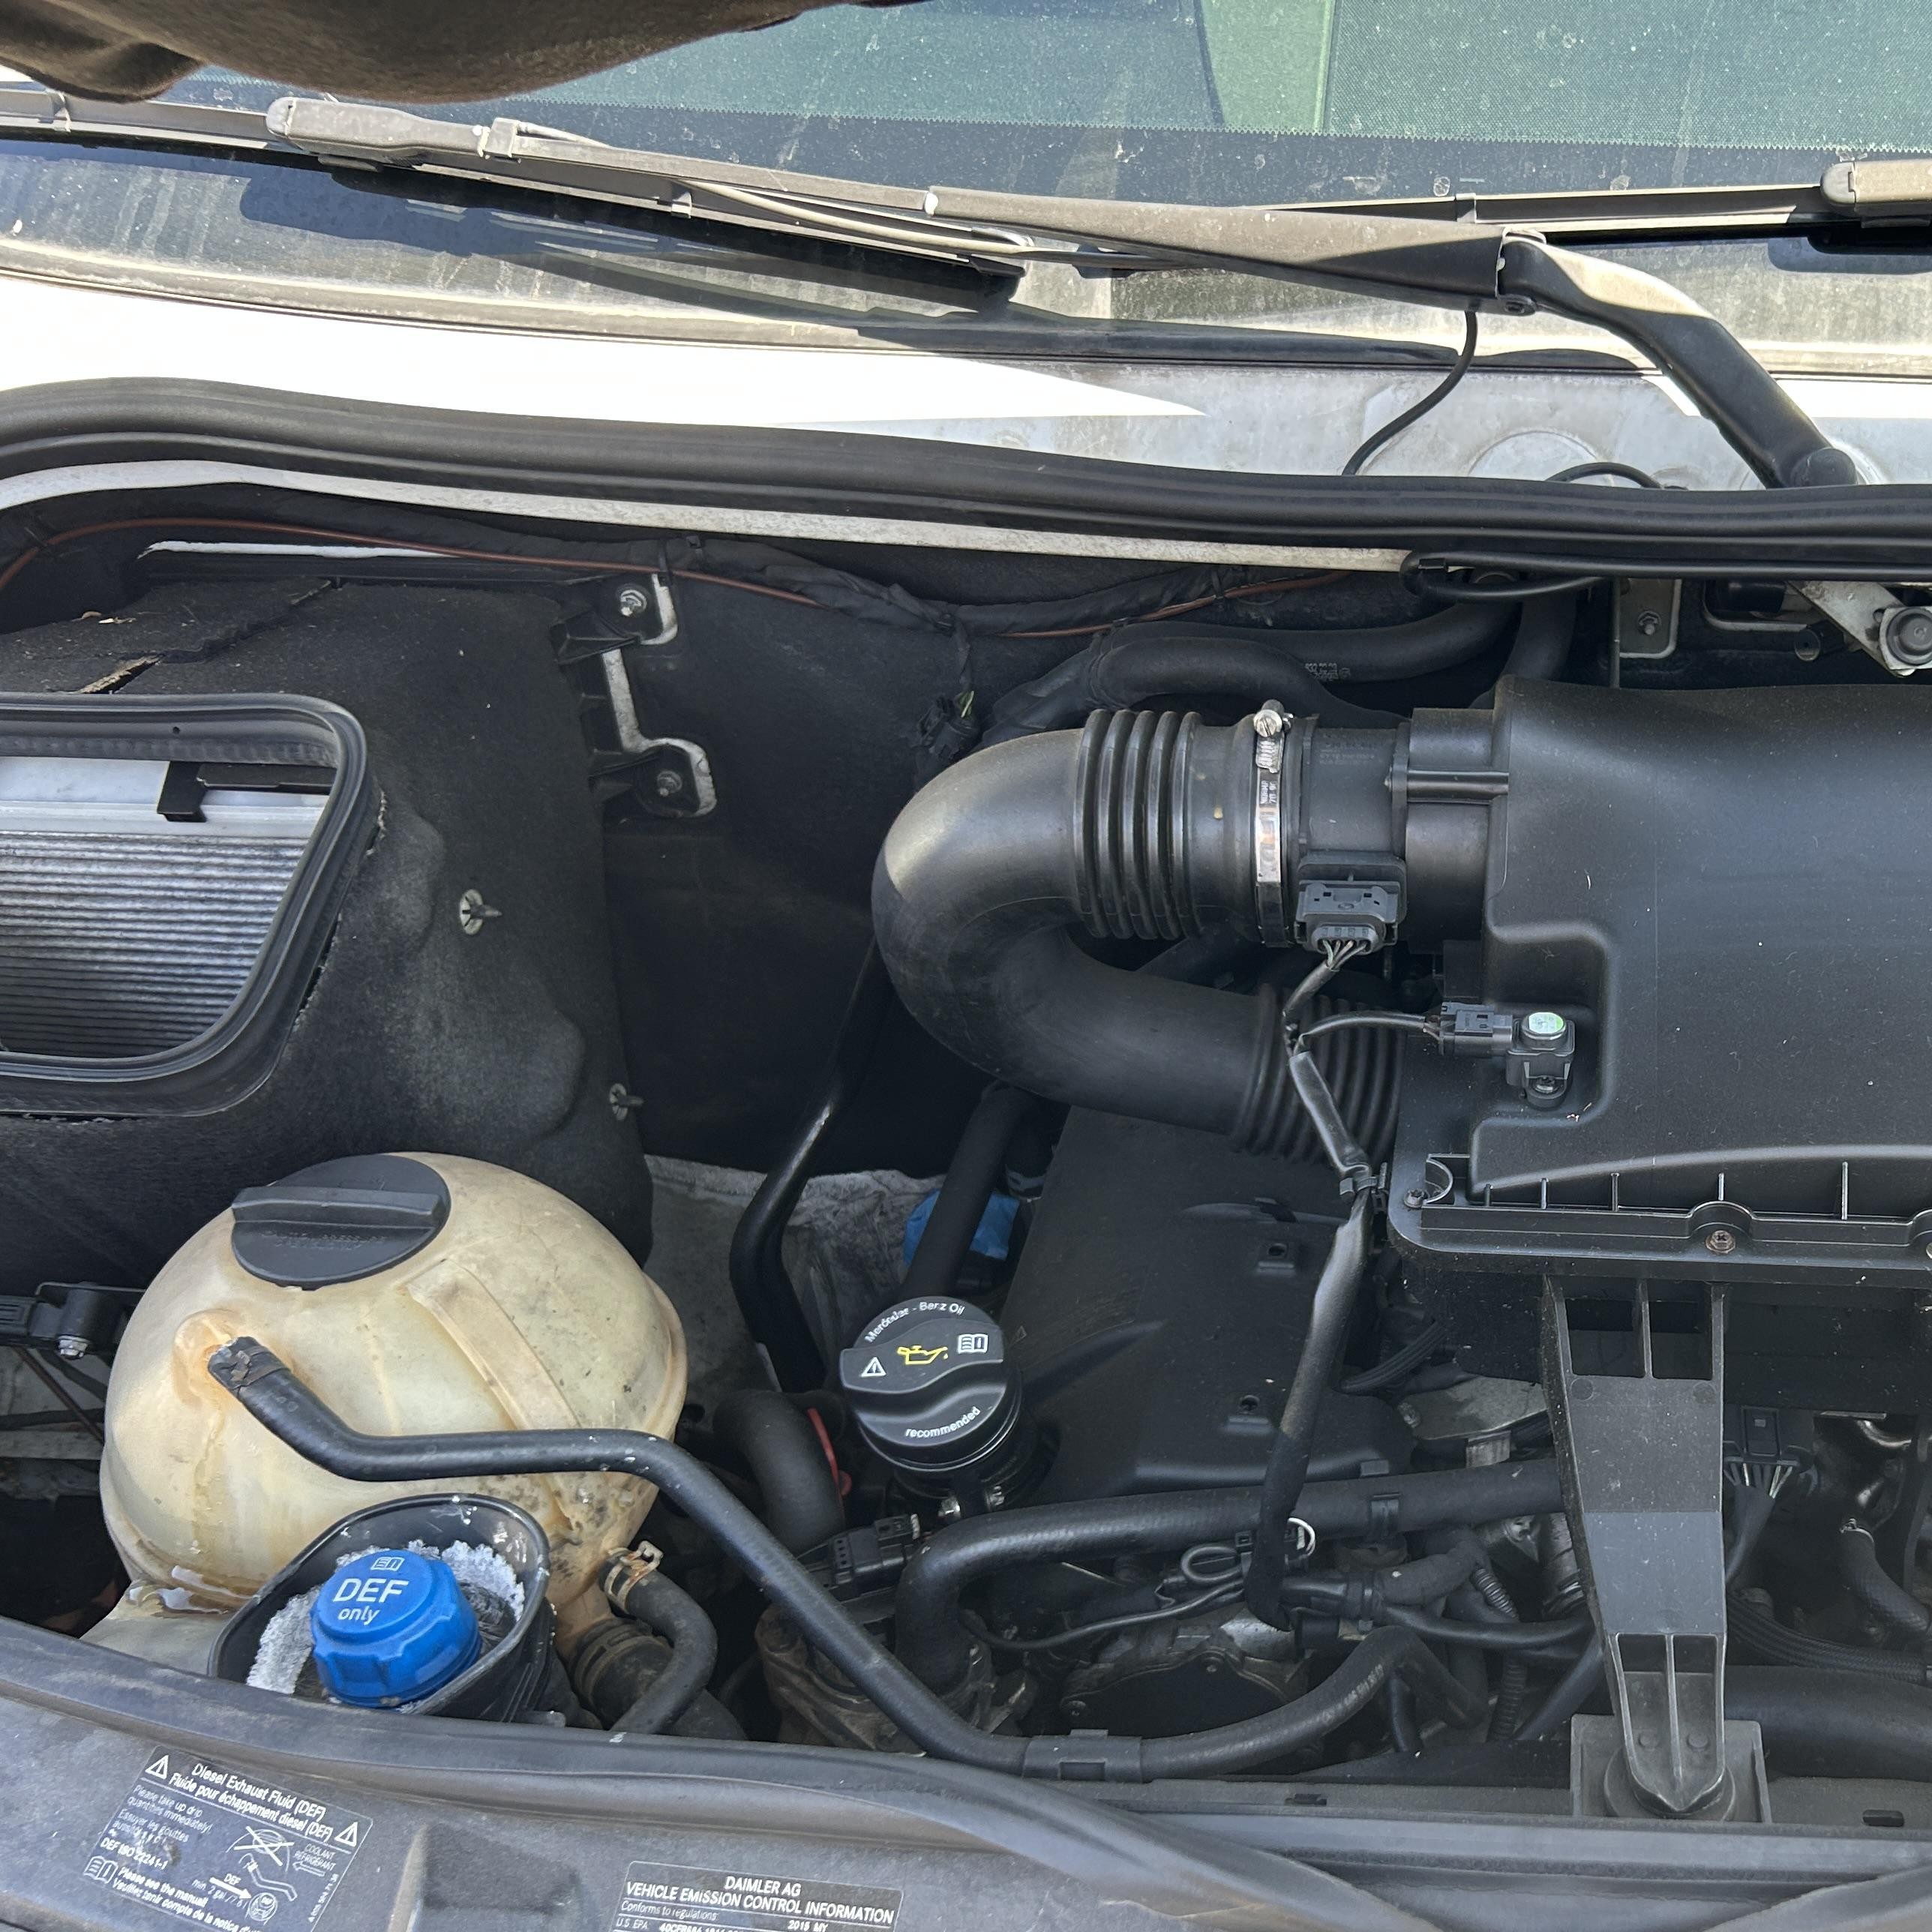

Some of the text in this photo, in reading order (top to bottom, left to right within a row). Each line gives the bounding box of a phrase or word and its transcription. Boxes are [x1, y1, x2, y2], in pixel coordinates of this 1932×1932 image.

[949, 1303, 965, 1315] Oil
[905, 1406, 981, 1438] recommended
[333, 1578, 410, 1603] DEF
[338, 1605, 381, 1626] only
[133, 1784, 160, 1802] Please
[158, 1794, 175, 1808] take
[175, 1802, 186, 1813] up
[191, 1763, 326, 1822] Diesel Exhaust Fluid (DEF)
[169, 1772, 334, 1843] Fluide pour échappement diesel (DEF)
[100, 1837, 122, 1851] DEF
[304, 1844, 336, 1859] COOLANT
[118, 1866, 146, 1884] Please
[145, 1878, 160, 1890] see
[160, 1882, 176, 1896] the
[224, 1874, 242, 1886] DEF
[724, 1876, 802, 1897] DAIMLER AG
[161, 1898, 194, 1916] compte
[192, 1909, 205, 1921] de
[204, 1912, 214, 1924] la
[621, 1900, 660, 1915] Conforms
[662, 1906, 670, 1916] to
[626, 1881, 895, 1924] VEHICLE EMISSION CONTROL INFORMATION
[633, 1920, 649, 1930] EPA
